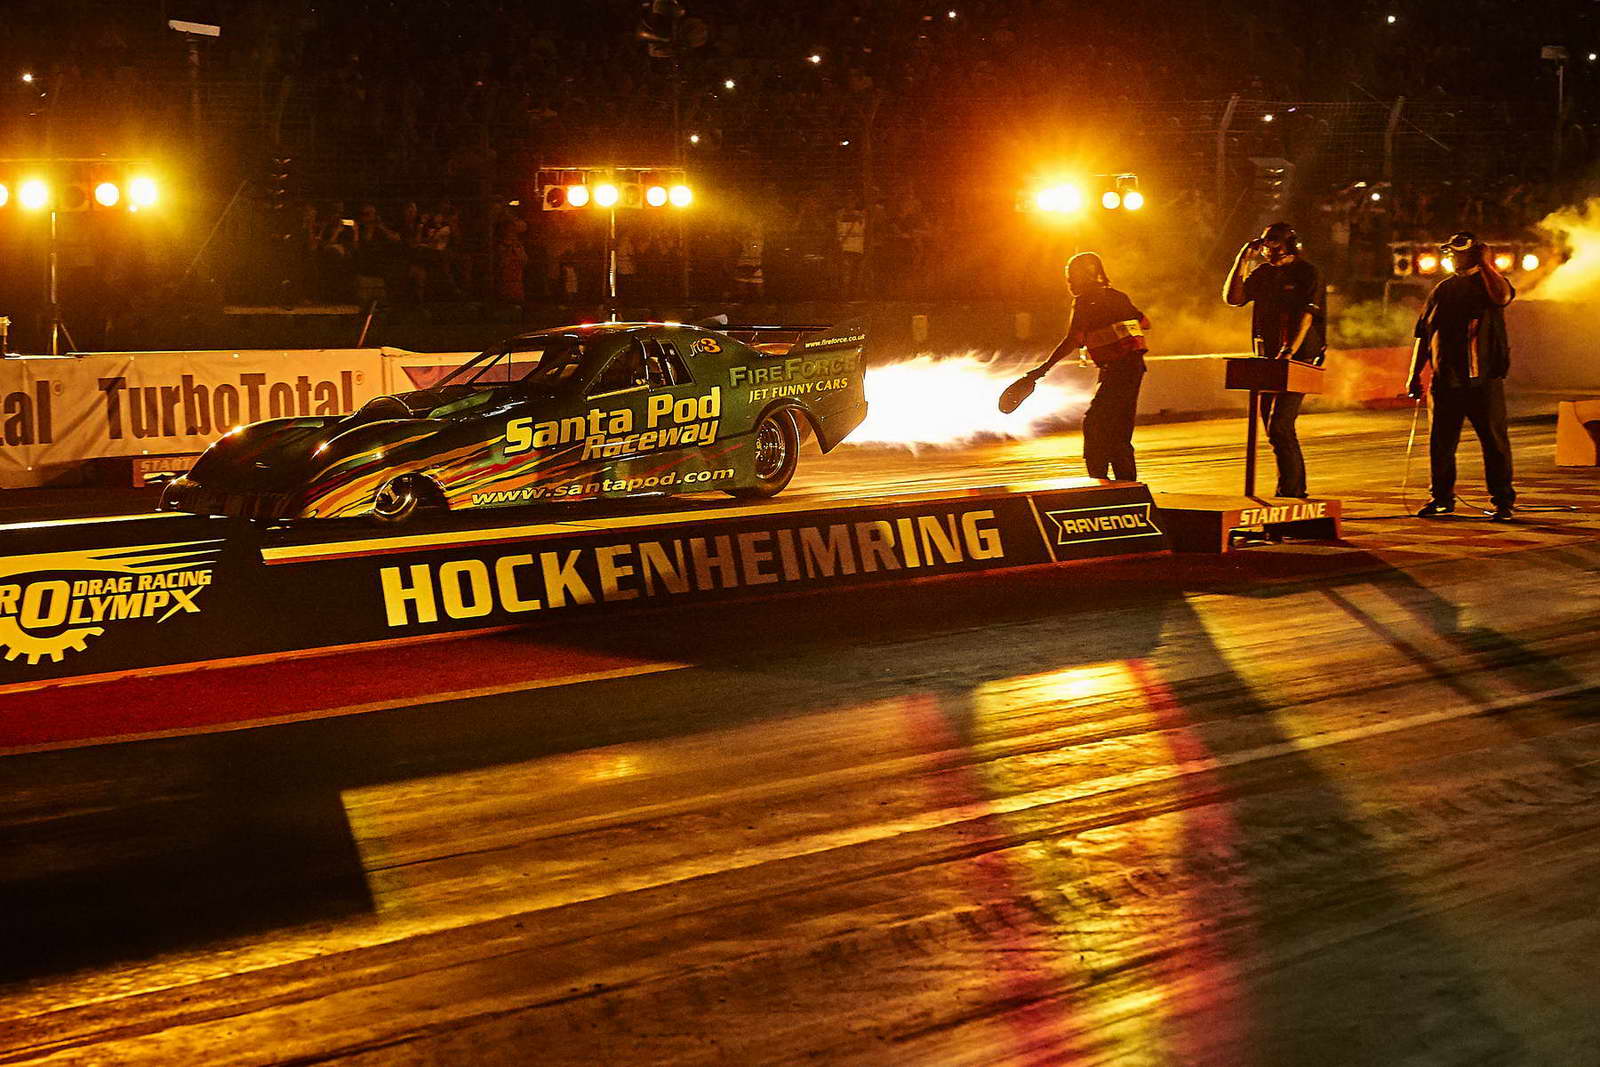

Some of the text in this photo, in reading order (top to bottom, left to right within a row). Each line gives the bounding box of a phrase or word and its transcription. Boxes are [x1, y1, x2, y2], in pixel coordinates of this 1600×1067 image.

[805, 335, 865, 348] www.fireforce.co.uk
[98, 371, 353, 440] TurboTotal
[749, 377, 848, 404] JET FUNNY CARS
[504, 386, 721, 454] Santa Pod
[580, 419, 719, 461] Raceway
[471, 467, 735, 506] www.santapod.com
[1062, 513, 1147, 534] RAVENOL
[1240, 502, 1327, 526] START LINE
[72, 569, 213, 597] DRAG RACING
[380, 509, 1005, 627] HOCKENHEIMRING
